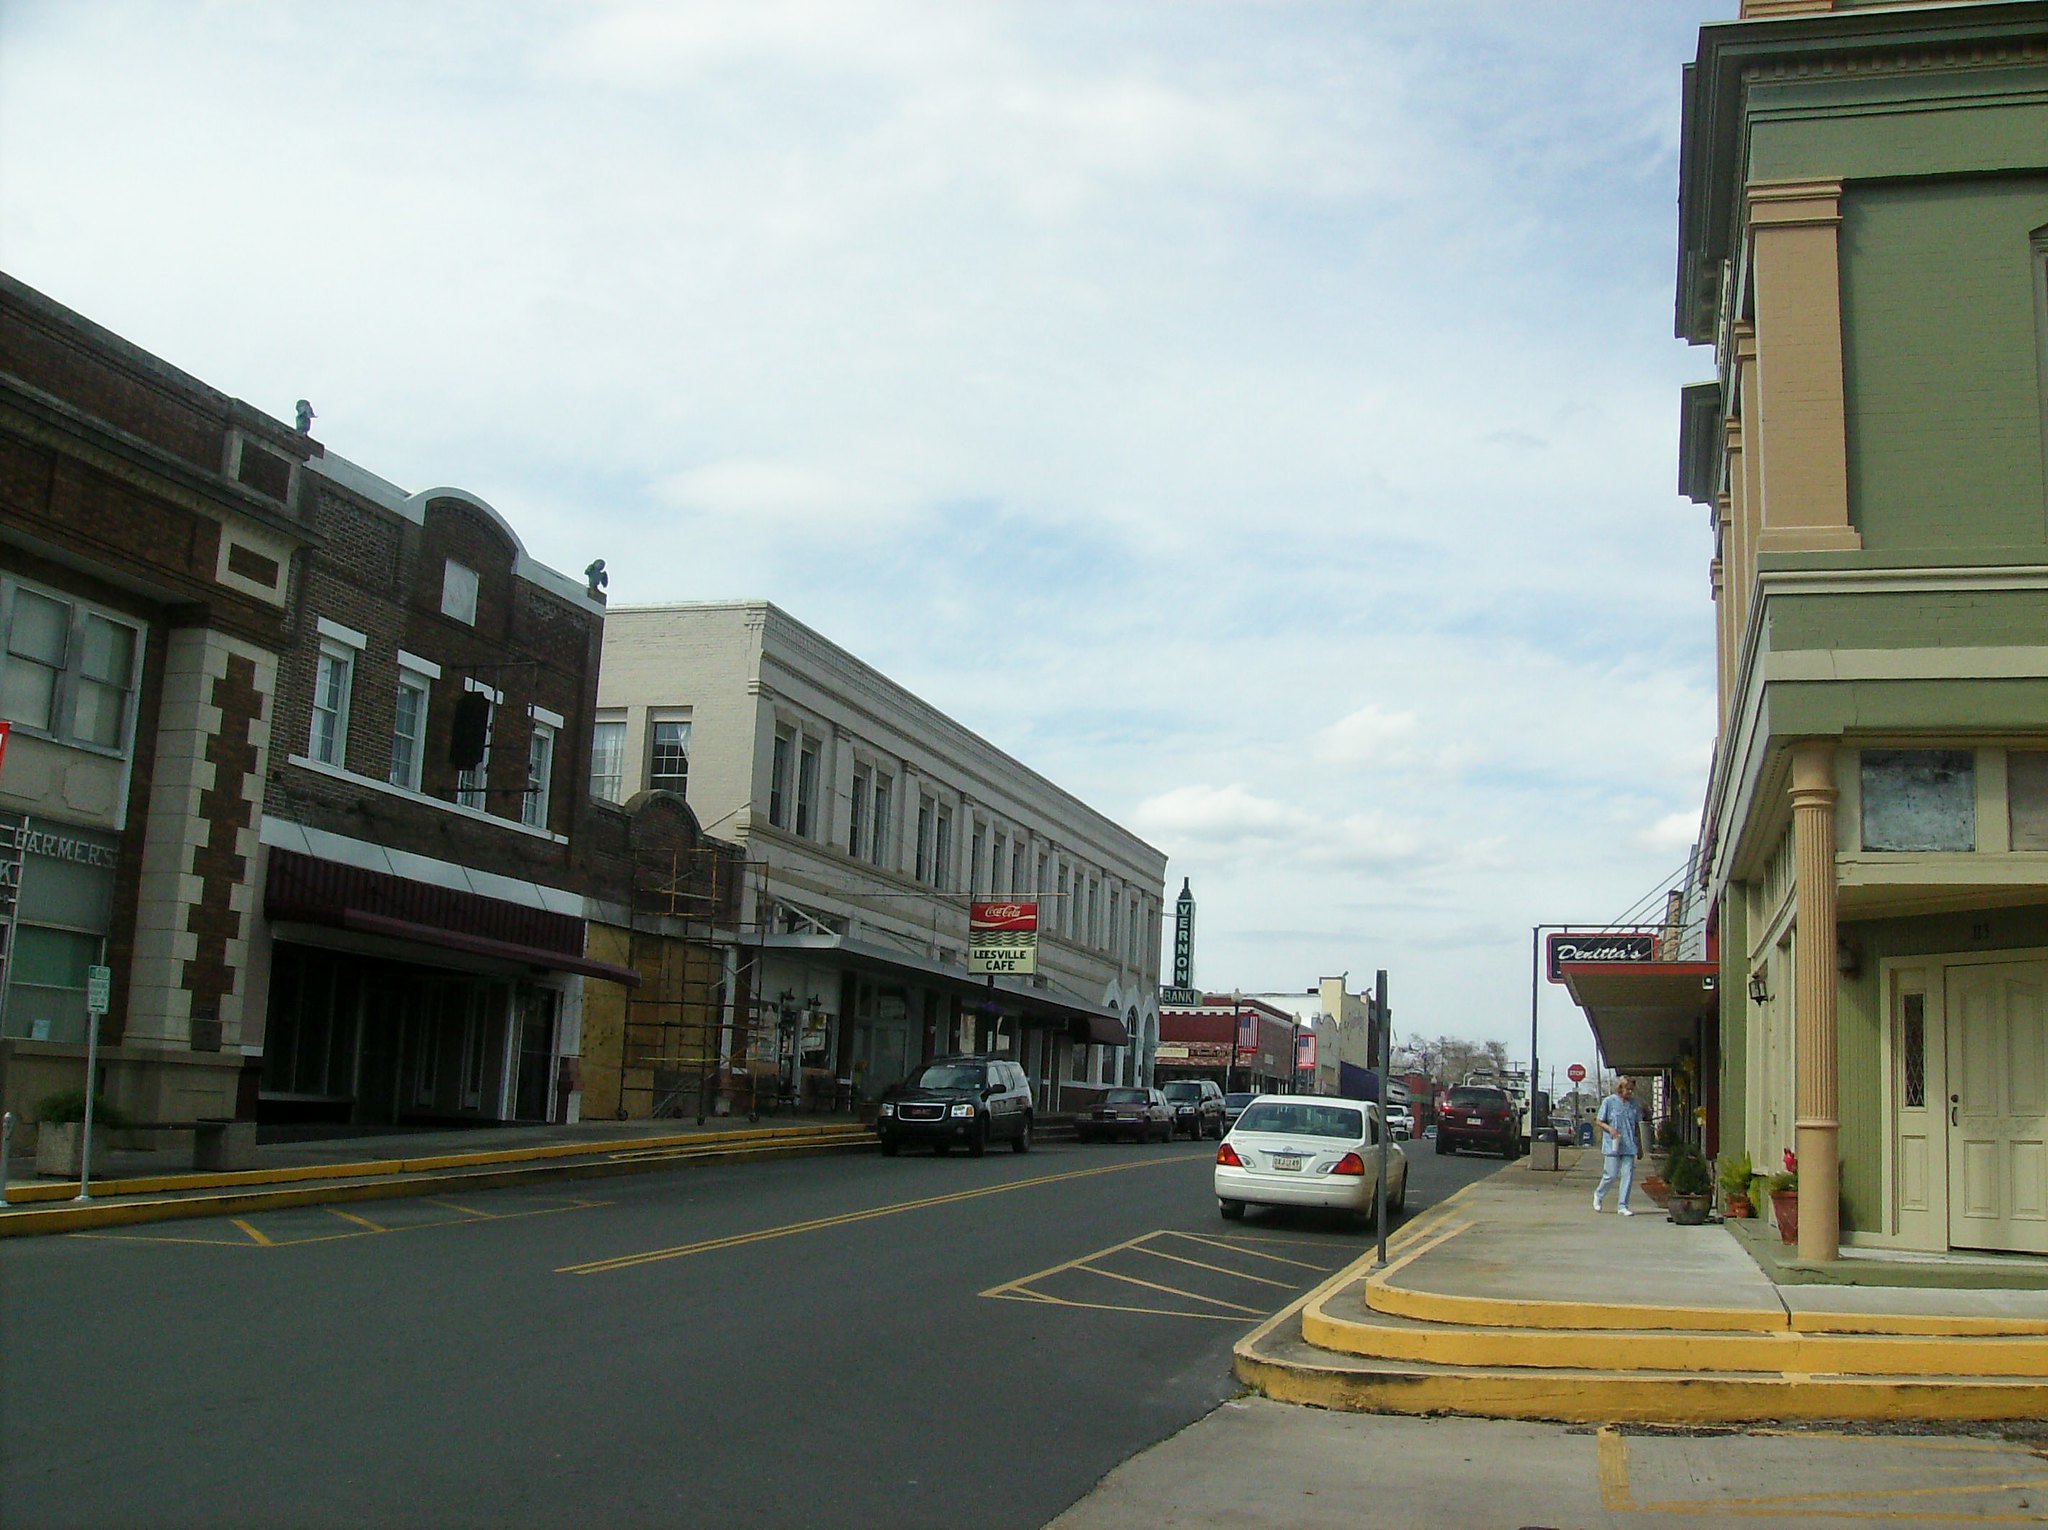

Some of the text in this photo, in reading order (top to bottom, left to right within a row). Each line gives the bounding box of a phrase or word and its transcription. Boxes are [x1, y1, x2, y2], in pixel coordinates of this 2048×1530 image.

[985, 905, 1021, 918] Coca-Cola
[1176, 904, 1190, 981] VERNON
[973, 950, 1027, 960] LEESVILLE
[986, 960, 1015, 971] CAFE
[1164, 989, 1193, 1004] BANK
[1569, 1069, 1585, 1077] STOP
